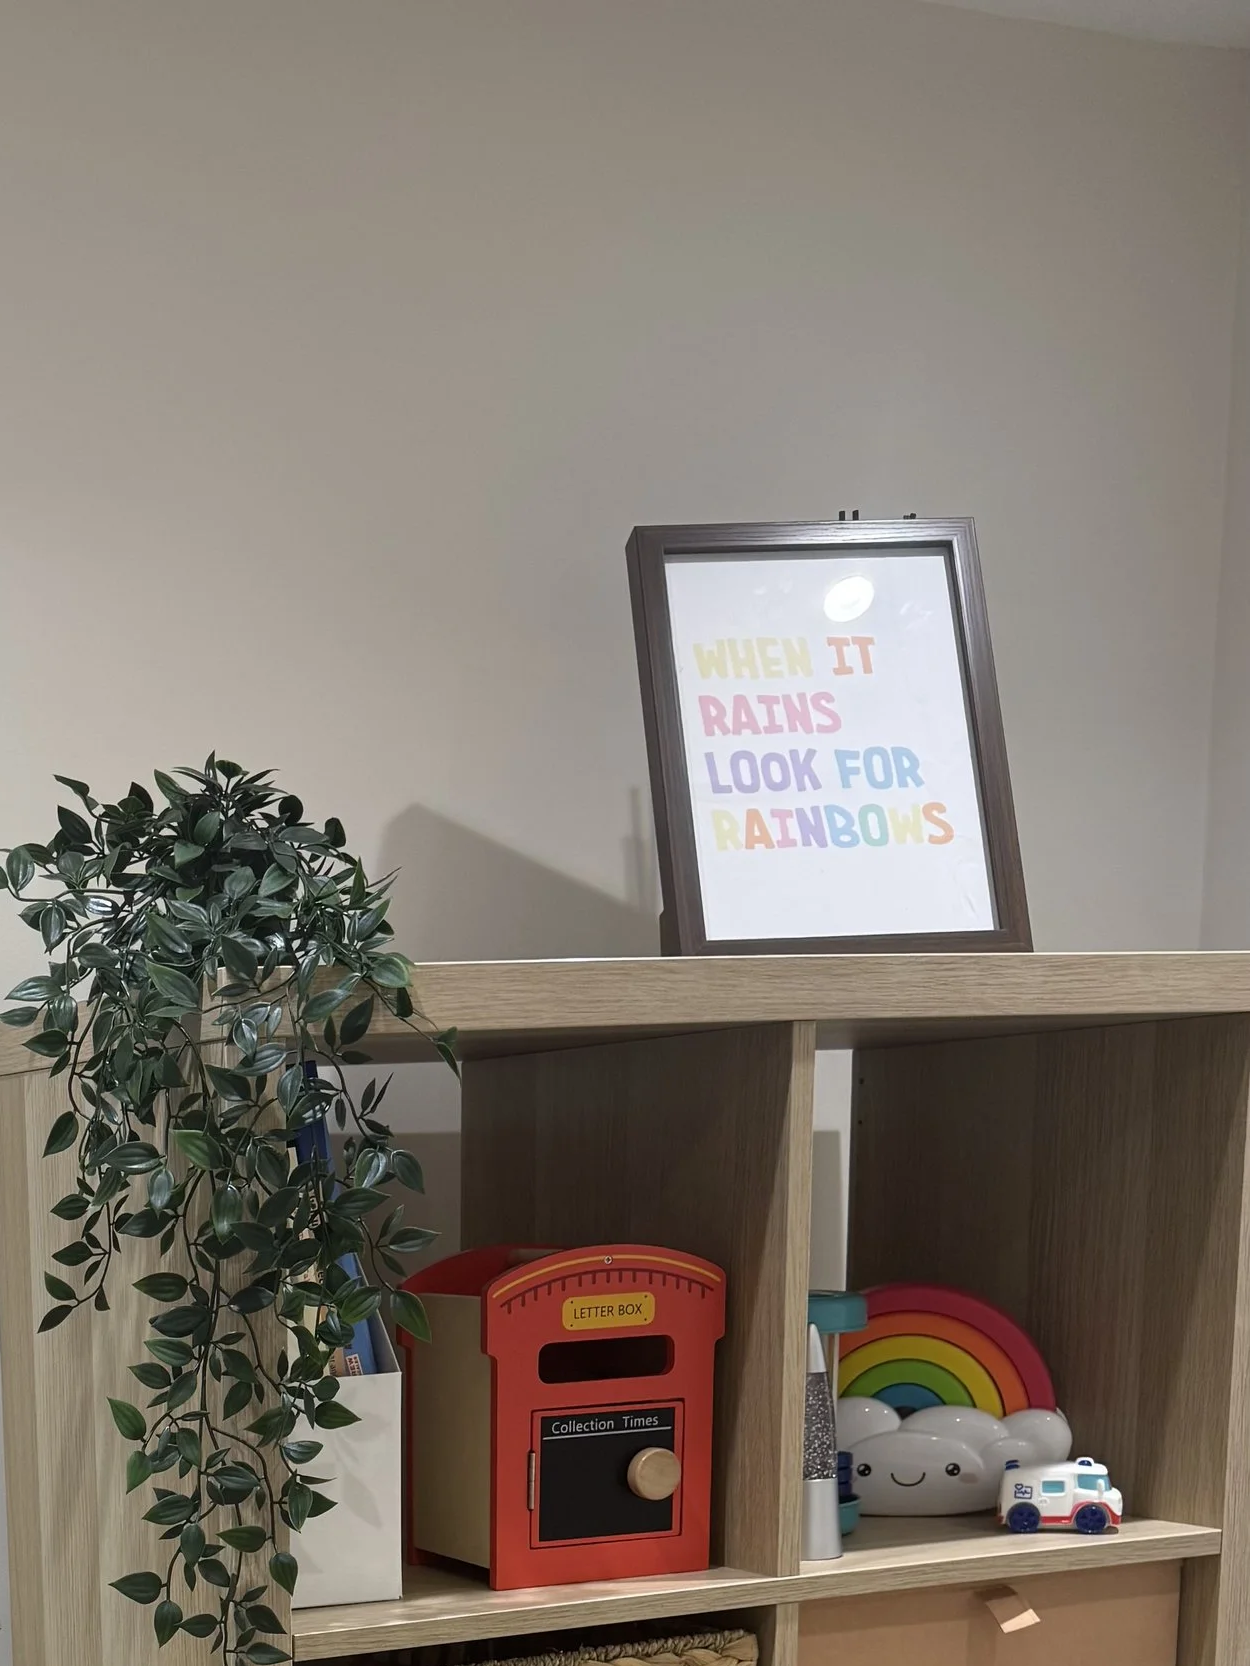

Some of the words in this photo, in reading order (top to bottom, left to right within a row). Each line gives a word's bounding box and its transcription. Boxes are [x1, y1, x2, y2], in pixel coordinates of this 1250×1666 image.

[692, 636, 813, 680] WHEN
[826, 636, 876, 676] IT
[697, 691, 842, 737] RAINS
[704, 748, 822, 794] LOOK
[833, 746, 925, 790] FOR
[710, 802, 955, 852] RAINBOWS
[573, 1305, 615, 1319] LETTER
[618, 1303, 643, 1316] BOX
[551, 1418, 615, 1434] Collection
[622, 1415, 659, 1429] Times
